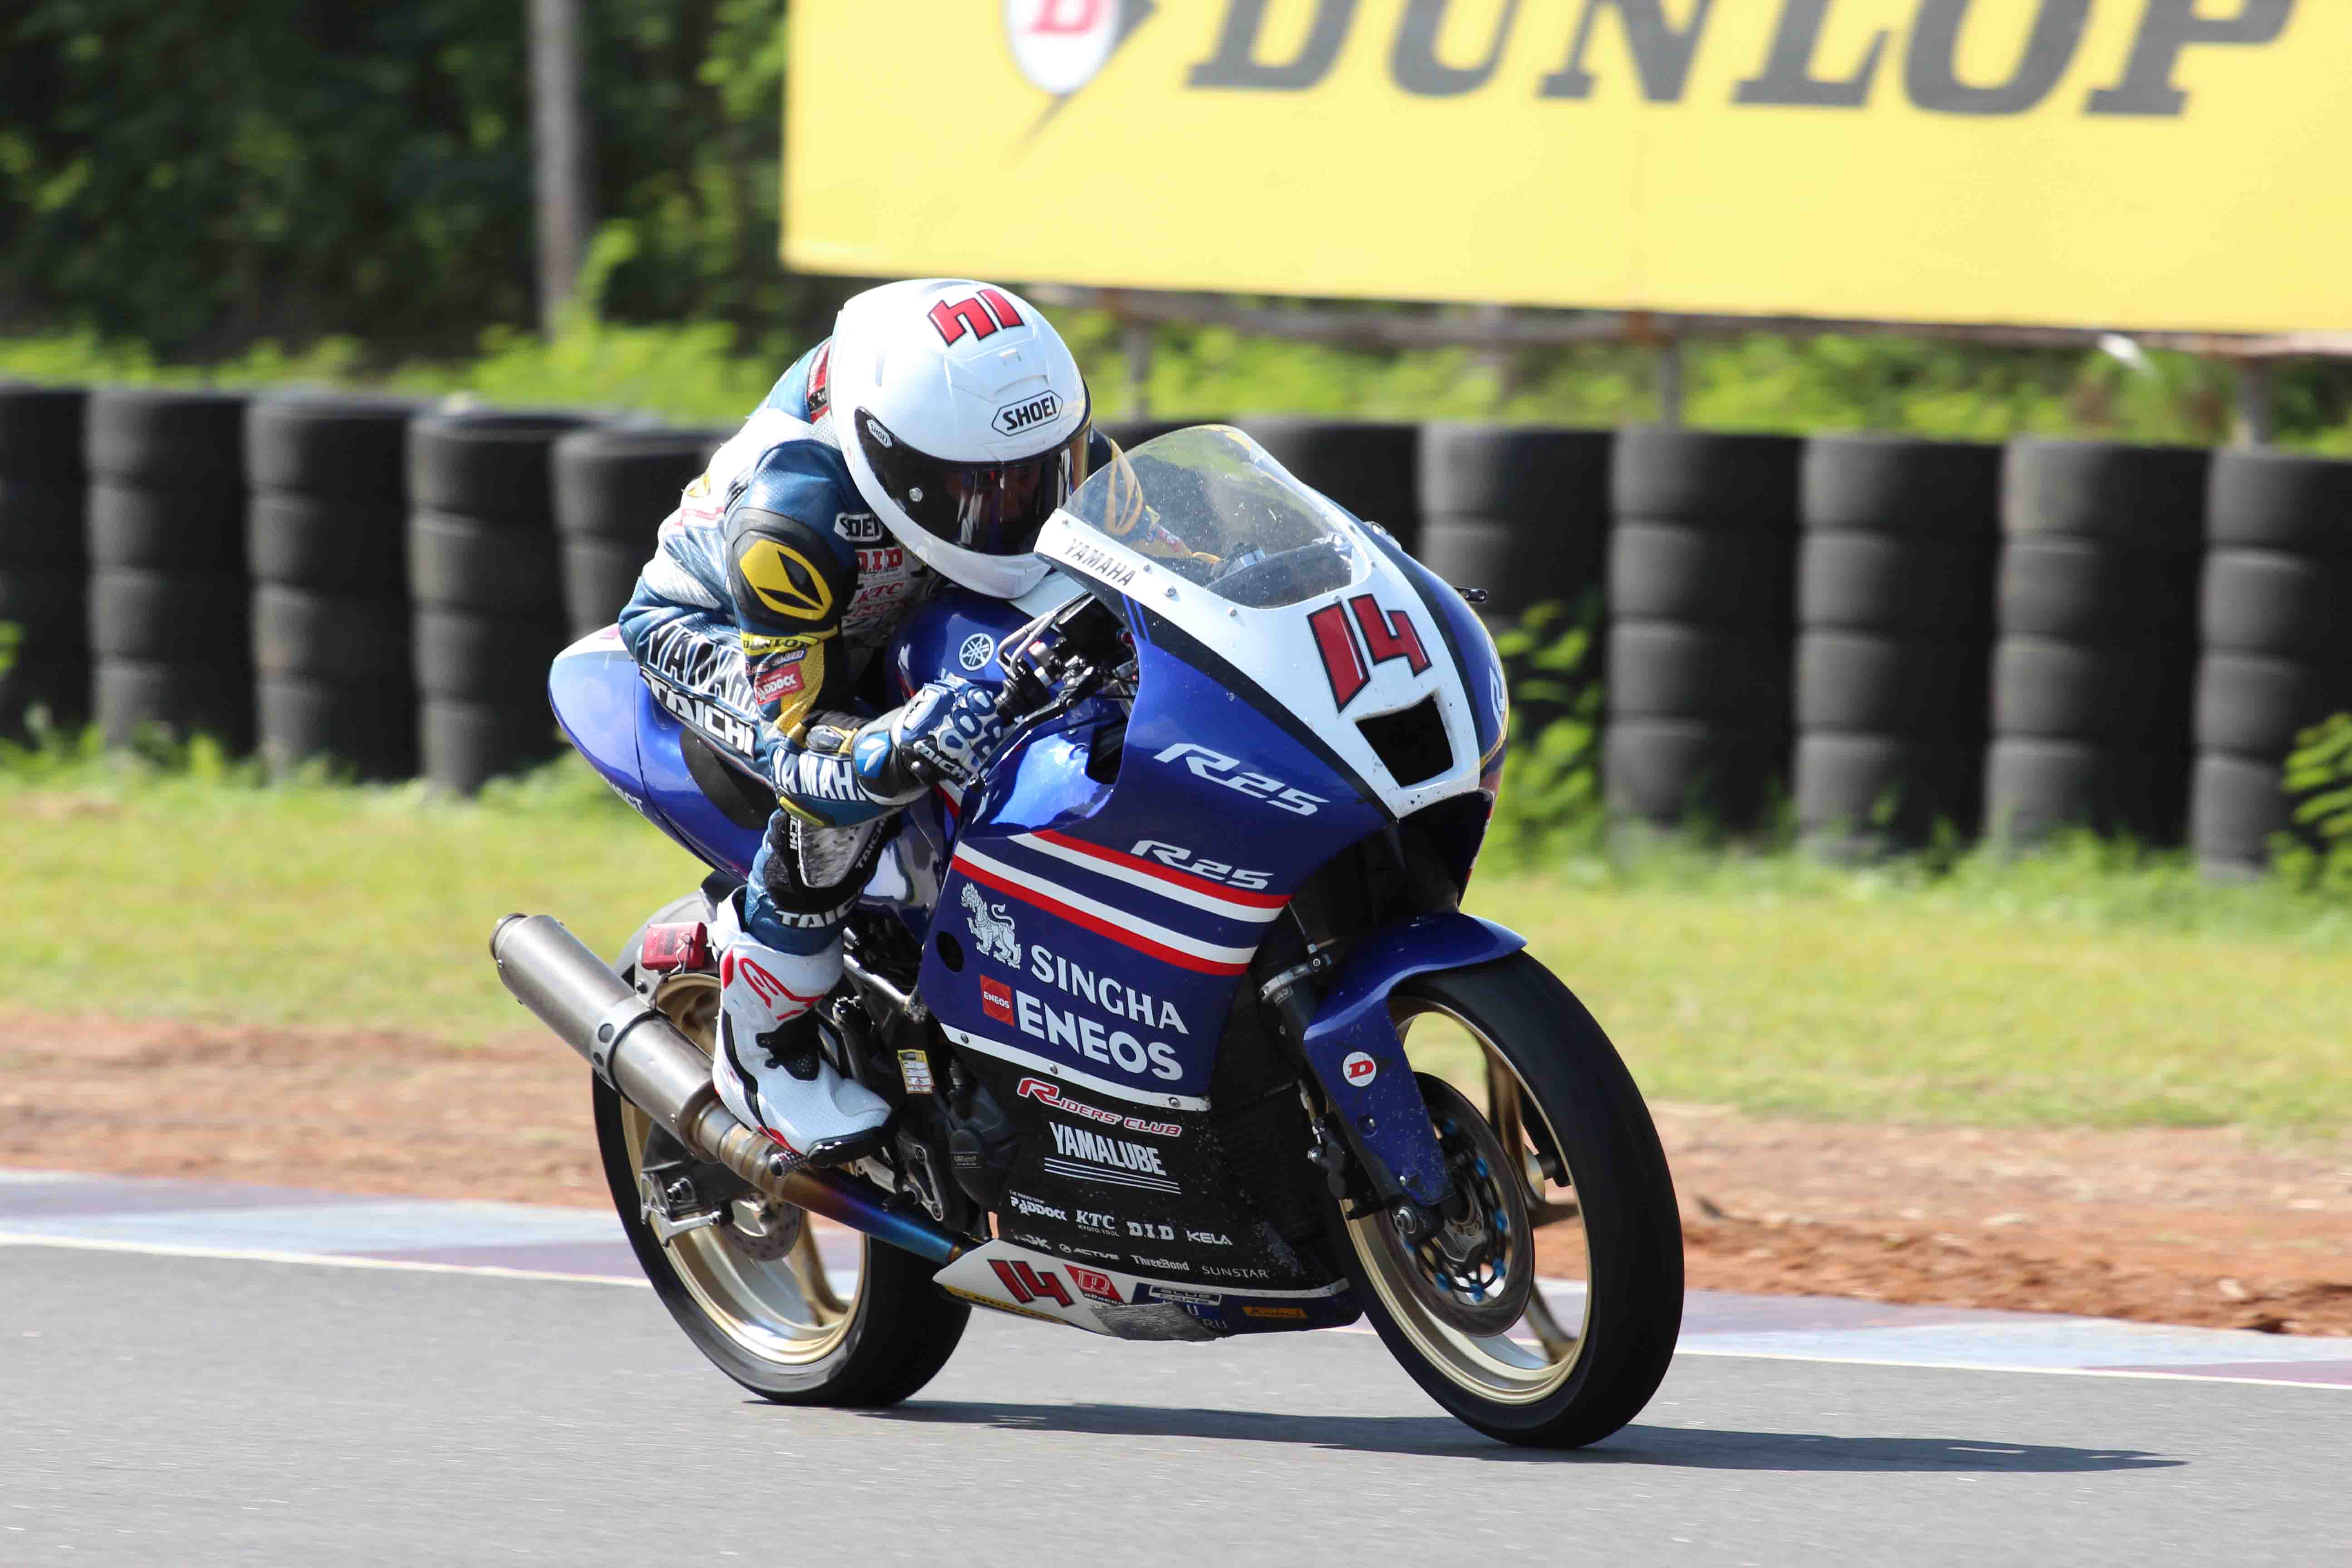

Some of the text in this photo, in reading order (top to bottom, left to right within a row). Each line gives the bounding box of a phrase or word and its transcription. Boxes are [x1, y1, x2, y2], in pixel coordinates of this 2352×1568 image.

[1185, 0, 2298, 116] DUNLOP
[1002, 396, 1058, 431] SHOEI
[871, 423, 887, 445] SHOEI
[839, 517, 880, 537] SOEI
[1063, 538, 1137, 587] YAMAHA
[1306, 593, 1432, 715] 14
[755, 673, 797, 702] ADDOCK
[642, 671, 755, 757] TAICHI
[1153, 742, 1330, 817] R25
[1130, 839, 1274, 890] R25
[775, 889, 860, 928] TAIC
[983, 990, 1010, 1009] ENEOS
[1030, 944, 1190, 1035] SINGHA
[1015, 989, 1183, 1081] ENEOS
[1348, 1060, 1374, 1079] D
[1123, 1118, 1182, 1137] CLUB
[1049, 1121, 1167, 1176] YAMALUBE
[1076, 1209, 1116, 1230] KTC
[1186, 1230, 1233, 1245] KELA
[1130, 1254, 1190, 1271] ThreeBond
[1202, 1265, 1269, 1278] SUNSTAR
[987, 1259, 1076, 1308] 14
